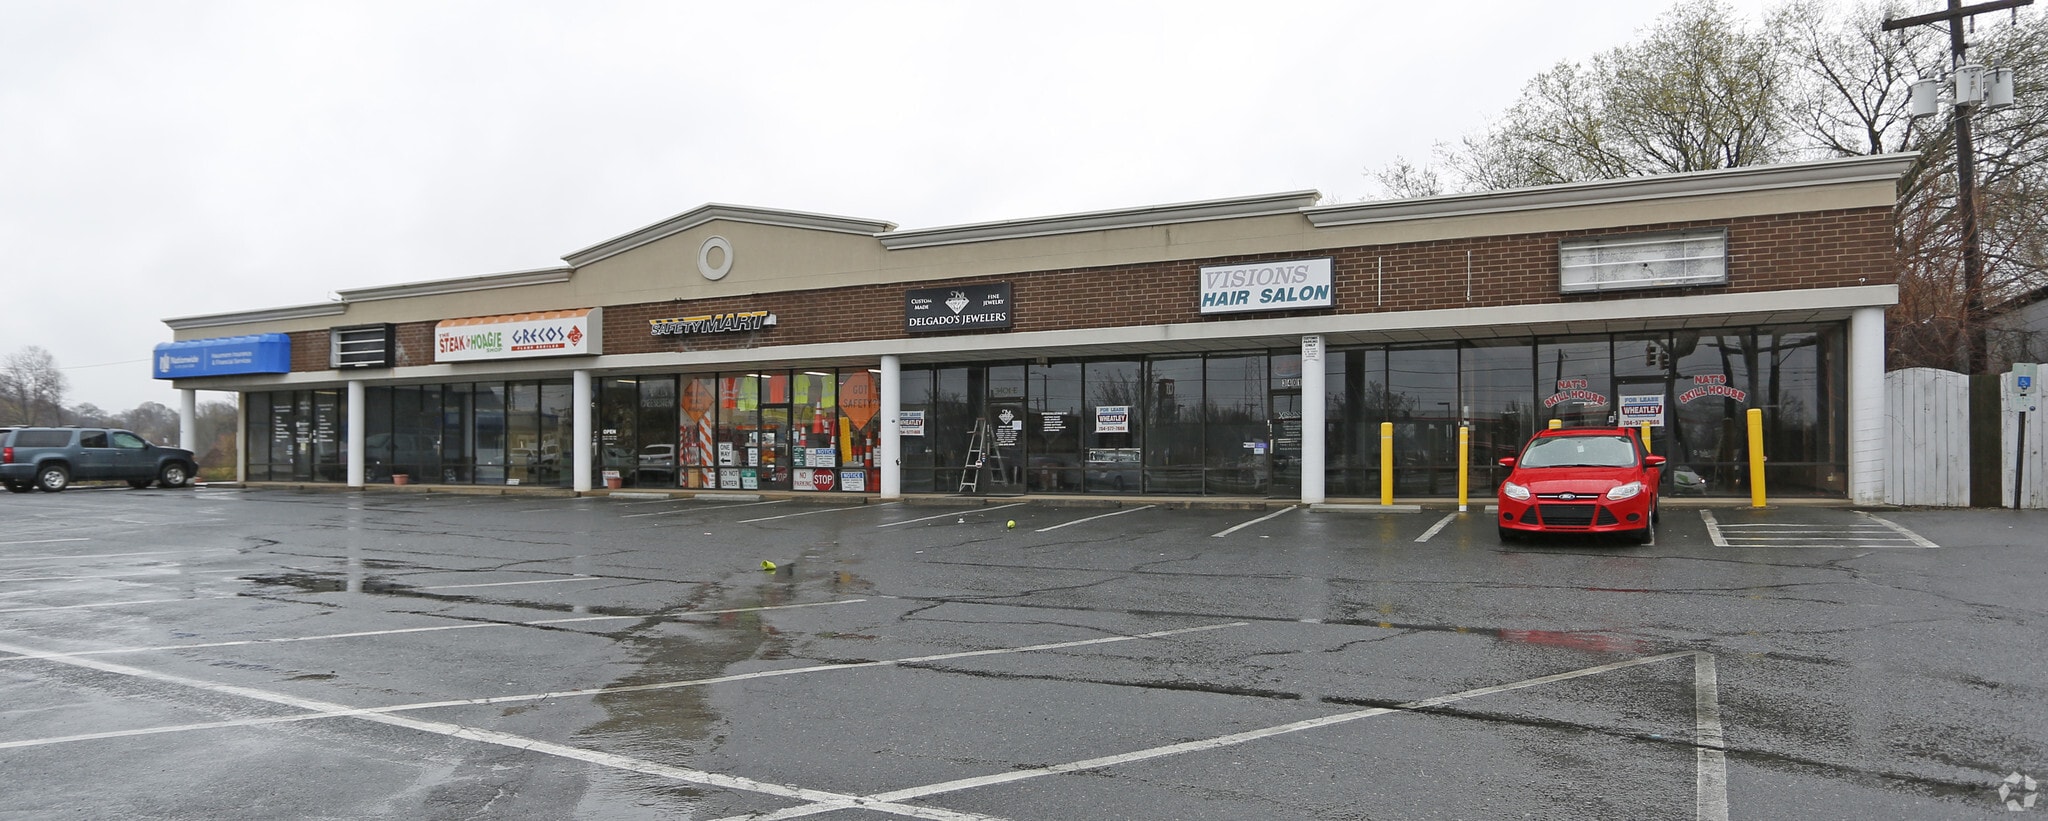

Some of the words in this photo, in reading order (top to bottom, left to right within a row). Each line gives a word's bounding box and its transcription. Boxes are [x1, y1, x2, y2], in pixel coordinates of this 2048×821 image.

[1205, 265, 1309, 289] VISIONS
[1202, 290, 1250, 307] HAIR
[1260, 285, 1329, 303] SALON
[909, 316, 960, 326] DELGADO'S
[962, 312, 1006, 325] JEWELERS
[439, 336, 465, 352] STEAK
[471, 332, 502, 350] HOAGIE
[512, 326, 564, 344] GRECOS
[1558, 379, 1587, 389] NAT'S
[1694, 374, 1726, 384] NAT'S
[853, 385, 867, 394] GOT
[1680, 387, 1707, 404] SKILL
[1707, 386, 1746, 402] HOUSE
[843, 399, 878, 408] SAFETY?
[1544, 391, 1570, 408] SKILL
[1570, 390, 1606, 406] HOUSE
[1624, 406, 1659, 414] WHEATLEY
[814, 475, 833, 484] STOP
